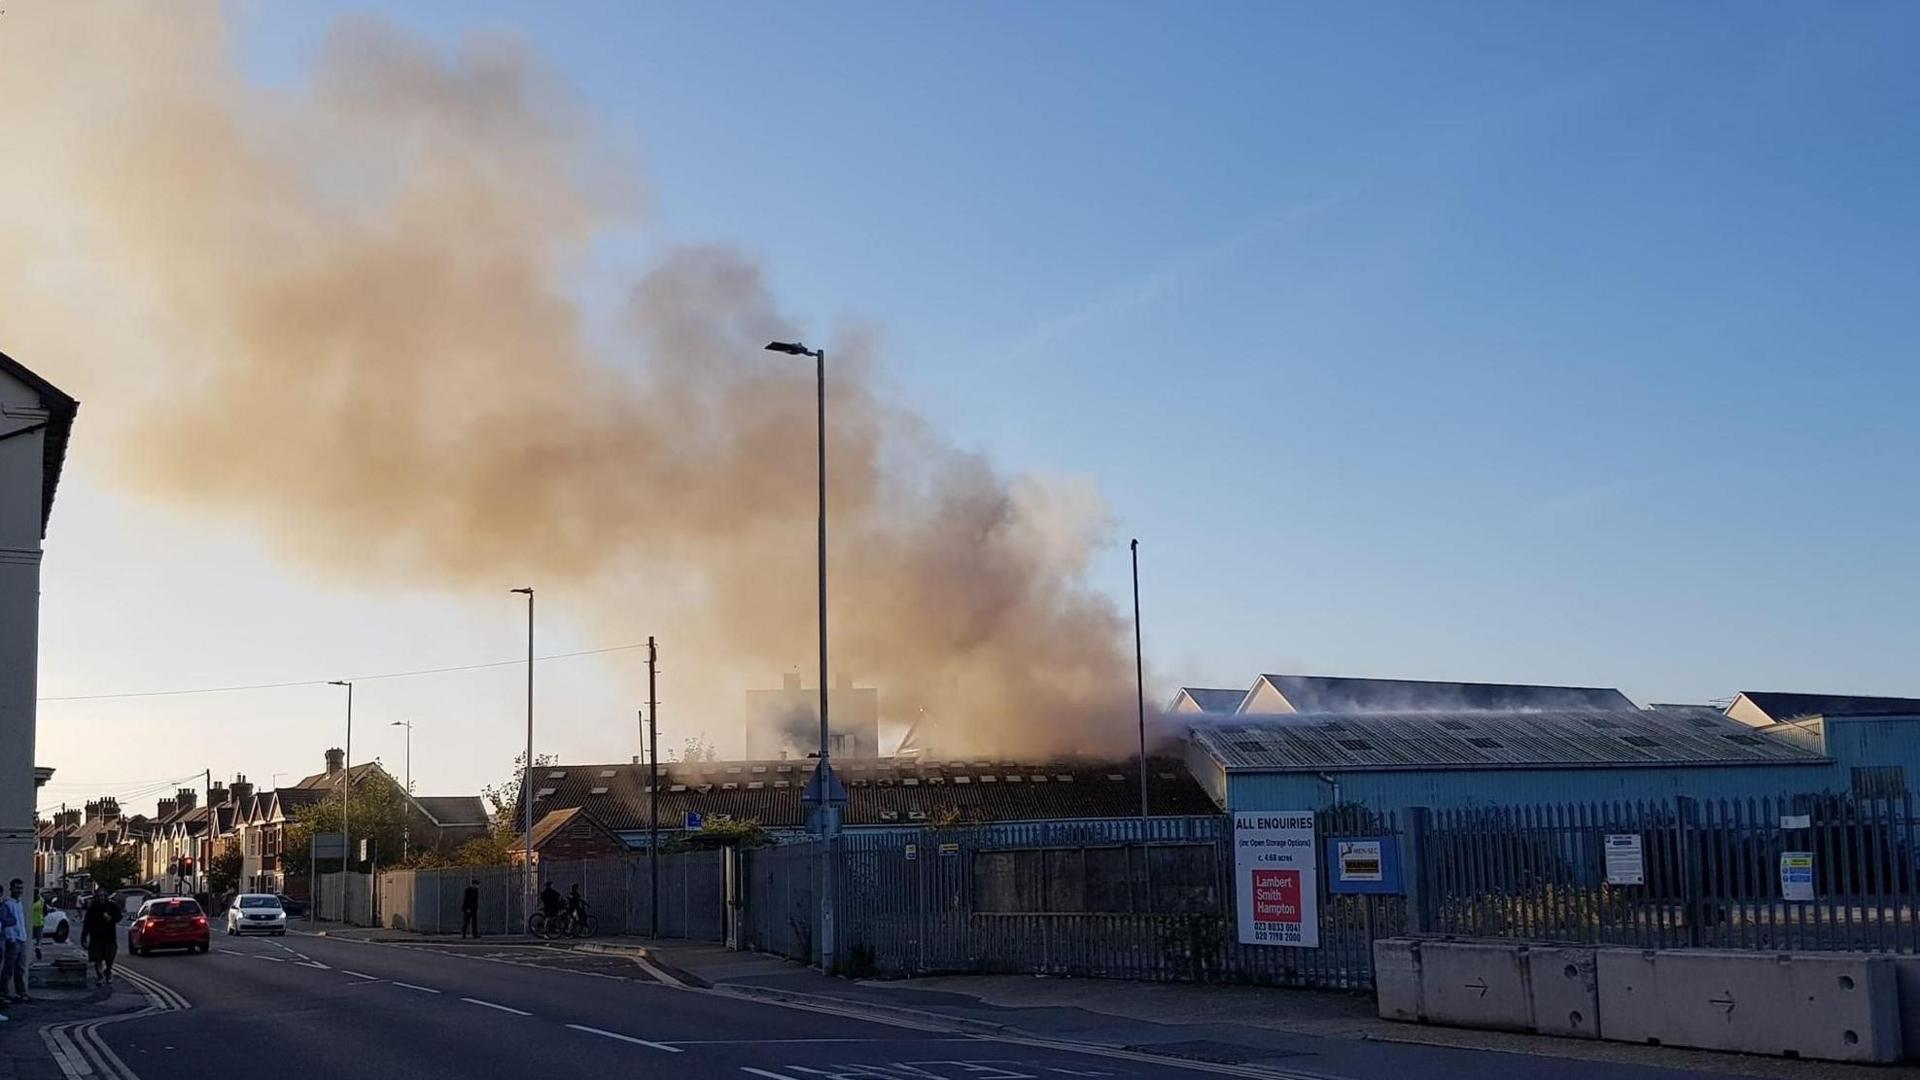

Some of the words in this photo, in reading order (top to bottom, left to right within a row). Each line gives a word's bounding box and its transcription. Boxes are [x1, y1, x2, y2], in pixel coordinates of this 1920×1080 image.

[1236, 817, 1254, 830] ALL
[1258, 817, 1313, 830] ENQUIRIES
[1250, 839, 1265, 848] Open
[1266, 839, 1286, 848] Storage
[1287, 839, 1311, 848] Options)
[1256, 875, 1292, 888] Lambert
[1257, 888, 1282, 901] Smith
[1257, 901, 1295, 916] Hampton
[1254, 922, 1266, 931] 023
[1255, 931, 1267, 940] 020
[1284, 932, 1301, 942] 2000
